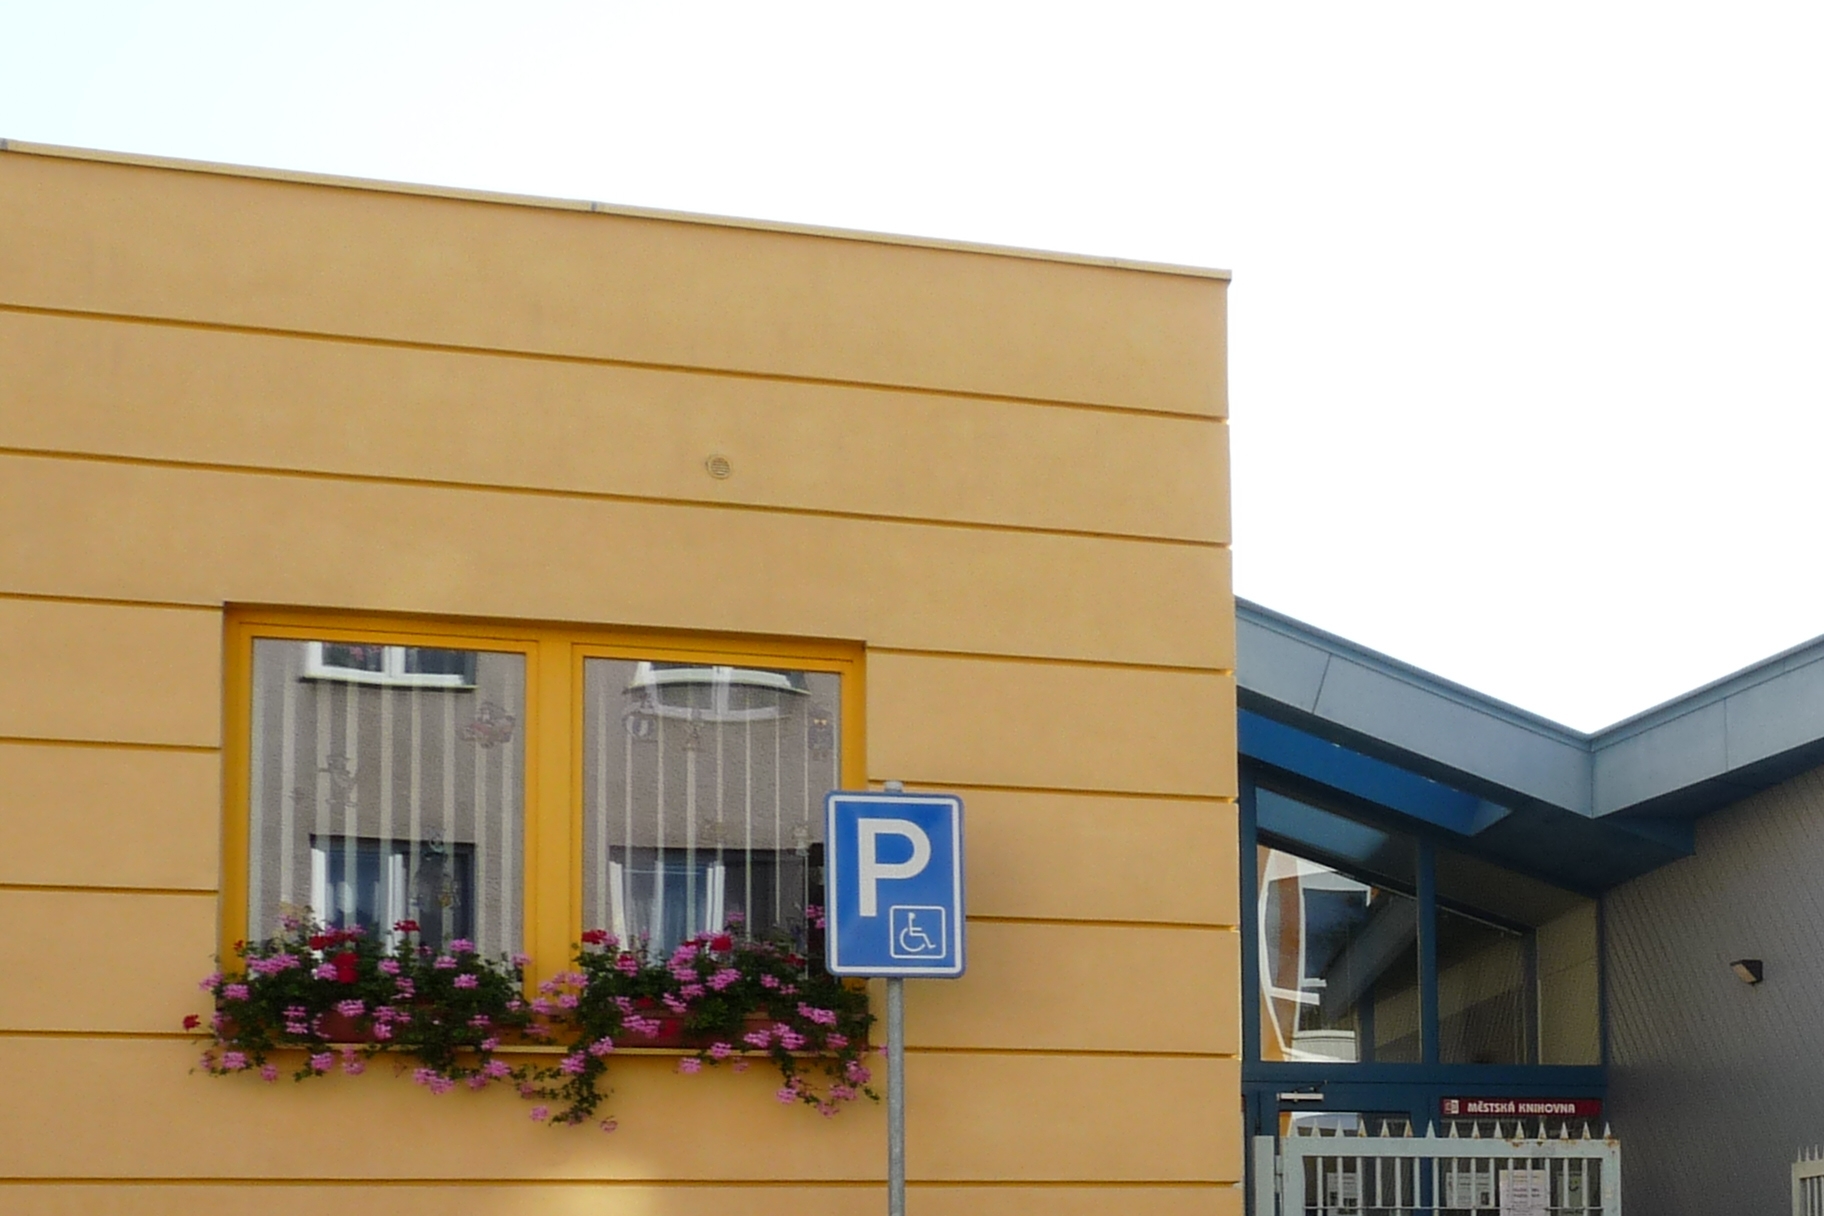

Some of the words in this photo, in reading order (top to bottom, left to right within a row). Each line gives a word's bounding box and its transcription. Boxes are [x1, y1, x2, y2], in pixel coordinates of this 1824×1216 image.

[858, 818, 931, 917] P
[1467, 1101, 1515, 1113] MĚSTSKÁ
[1519, 1103, 1575, 1114] KNIHOVNA
